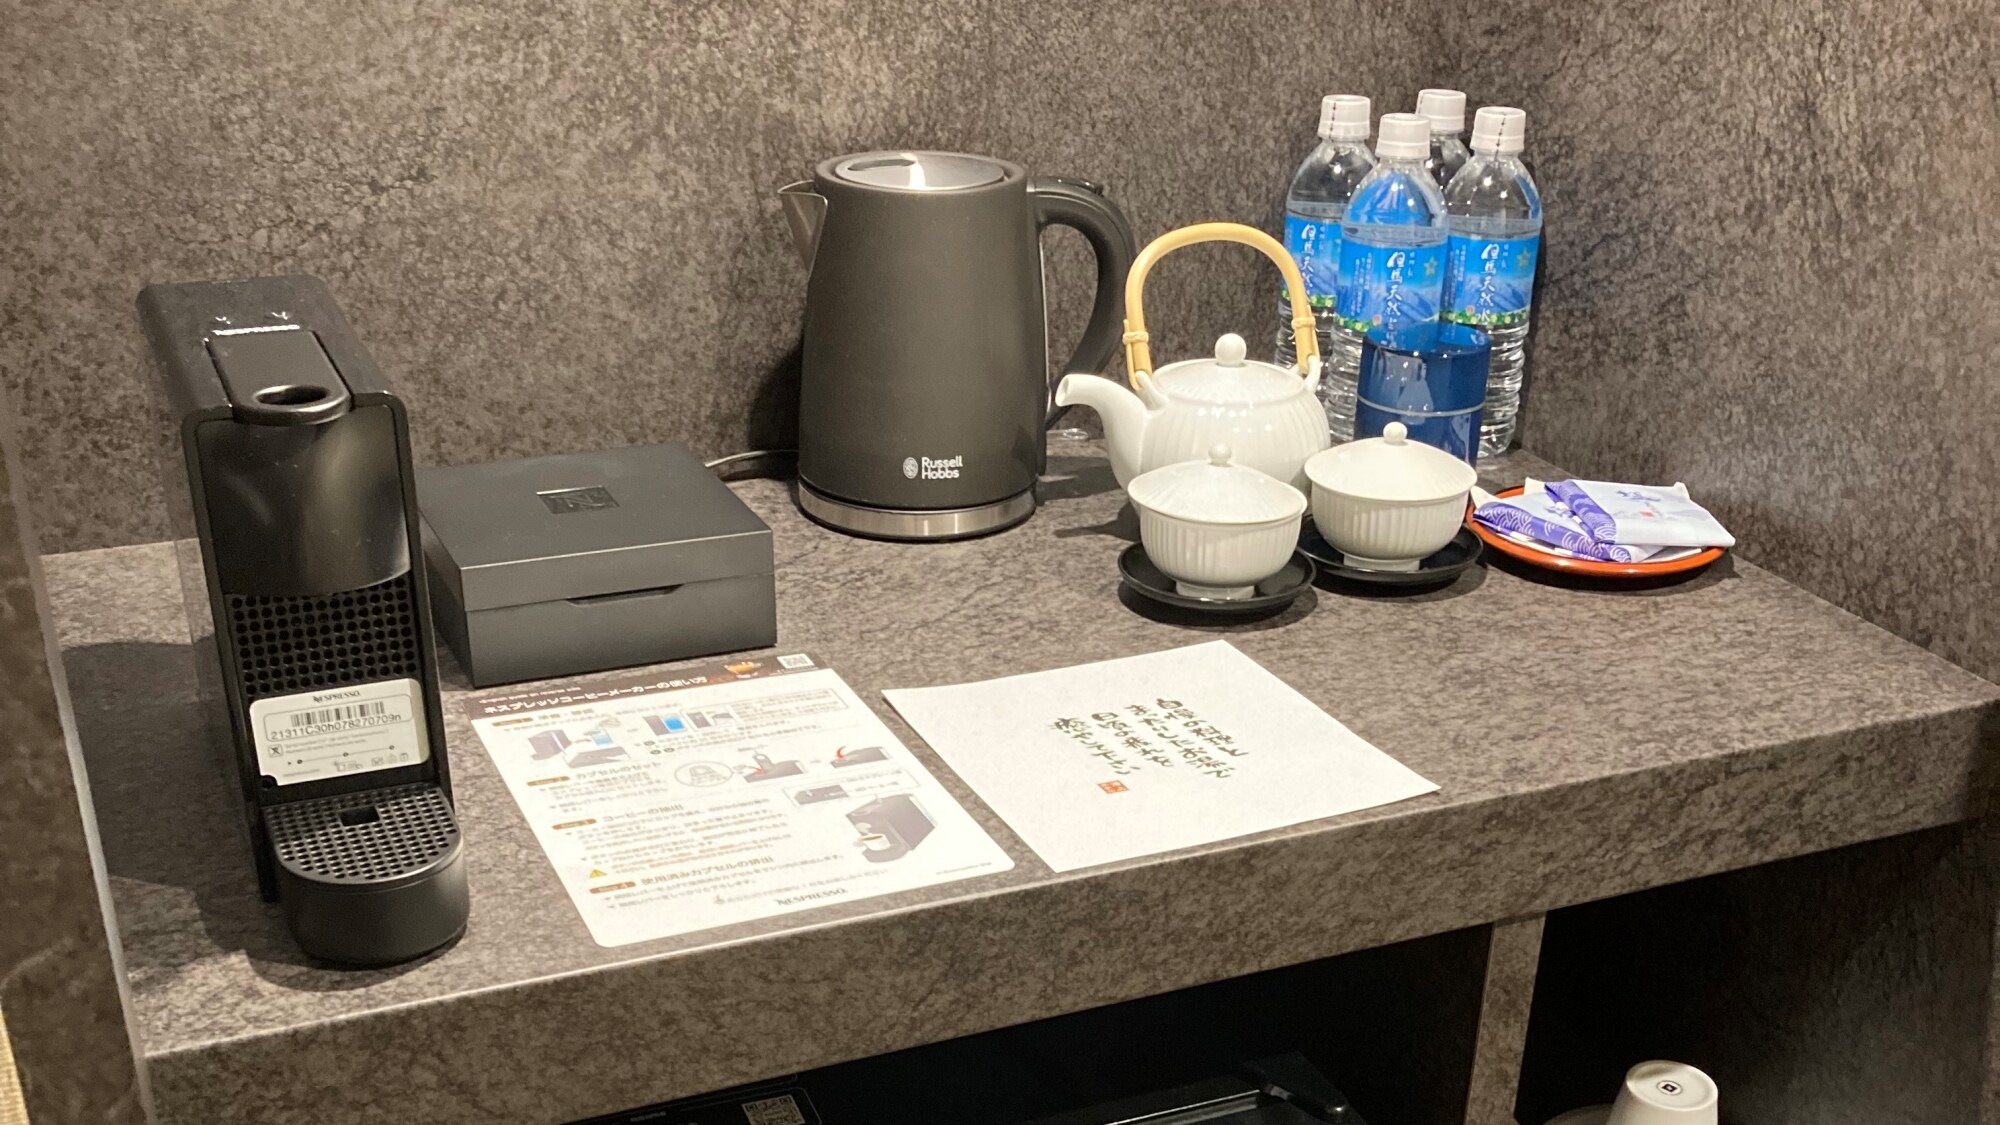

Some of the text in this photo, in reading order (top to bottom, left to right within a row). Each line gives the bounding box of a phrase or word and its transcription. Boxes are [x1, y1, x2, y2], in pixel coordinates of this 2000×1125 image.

[921, 455, 963, 469] Russell
[921, 467, 960, 480] Hobbs
[484, 676, 708, 714] ネスプレッソコーヒーメーカーの使い方
